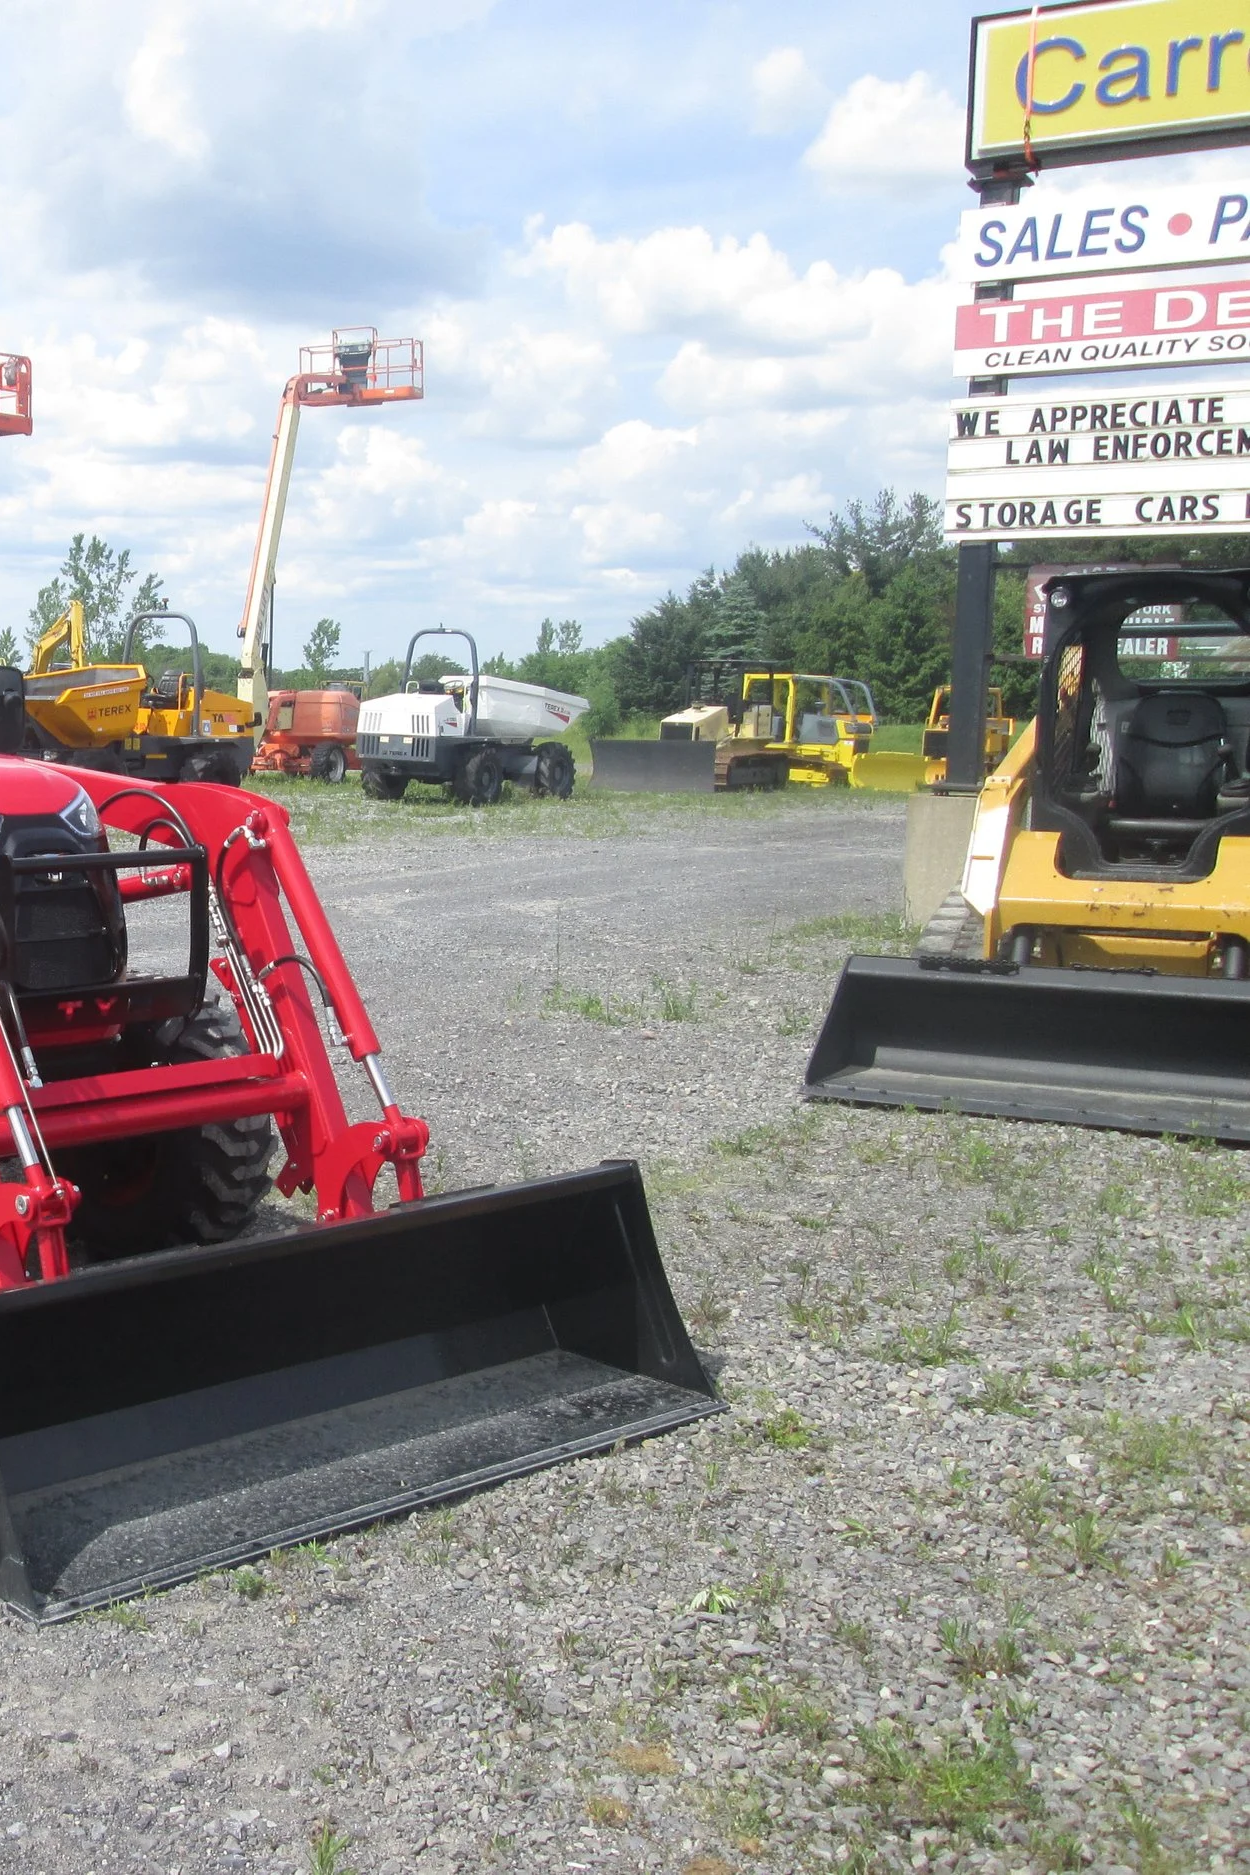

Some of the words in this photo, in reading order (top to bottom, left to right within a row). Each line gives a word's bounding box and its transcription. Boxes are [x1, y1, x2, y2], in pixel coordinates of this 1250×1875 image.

[1014, 28, 1250, 116] Carr
[974, 205, 1149, 268] SALES
[1208, 194, 1250, 244] P
[979, 301, 1124, 343] THE
[985, 348, 1072, 369] CLEAN
[1080, 338, 1201, 362] QUALITY
[1207, 334, 1250, 351] SO
[956, 411, 1000, 437] WE
[1028, 397, 1224, 433] APPRECIATE
[1006, 438, 1069, 465] LAW
[956, 499, 1102, 528] STORAGE
[1135, 495, 1220, 523] CARS
[98, 704, 132, 717] TEREX
